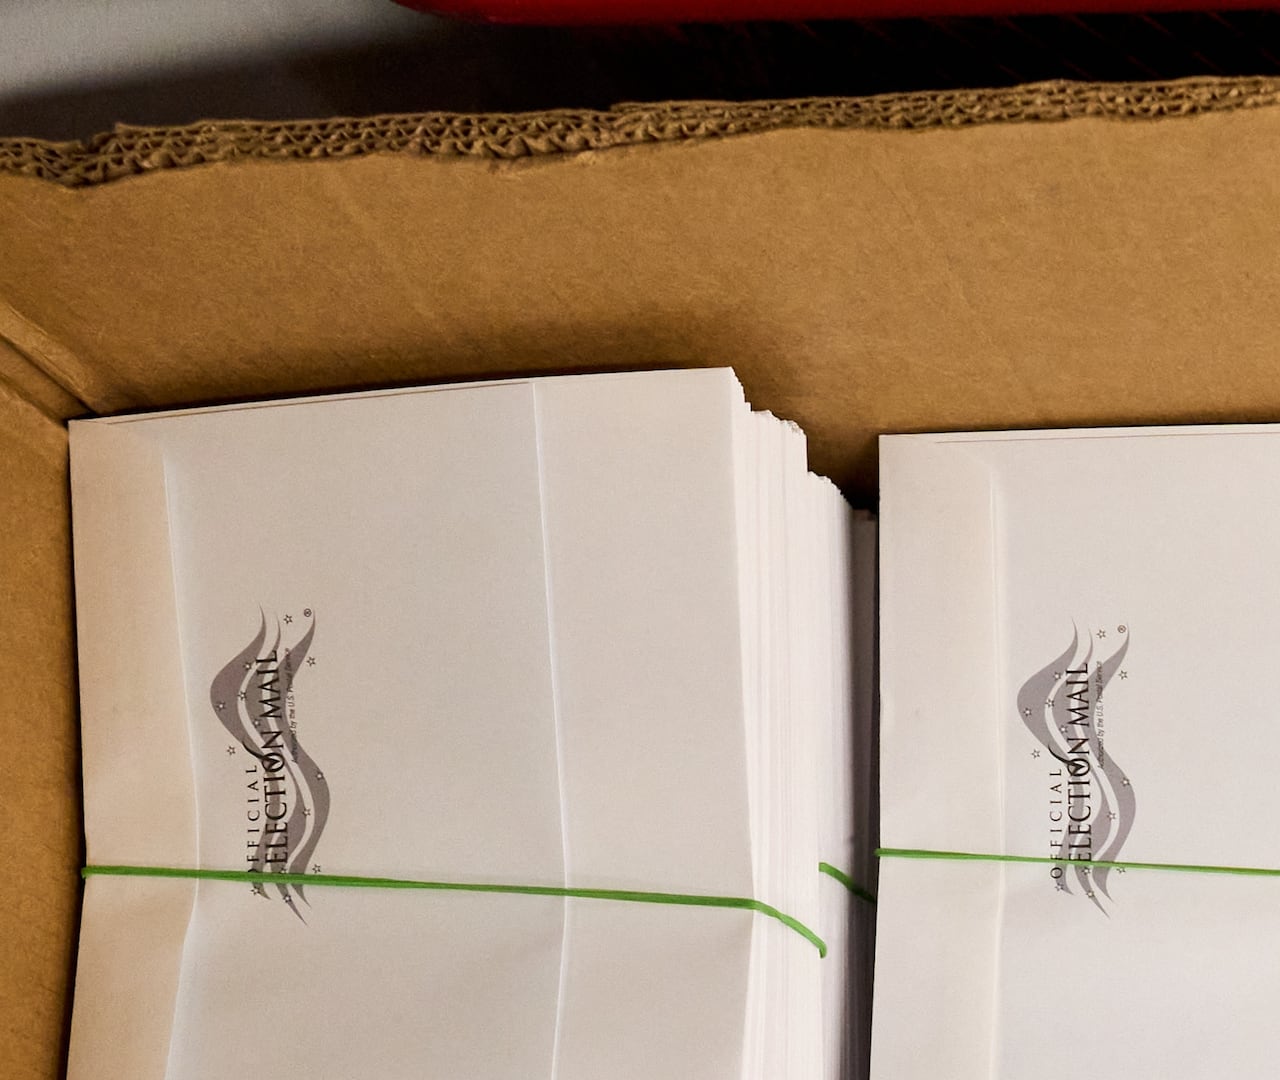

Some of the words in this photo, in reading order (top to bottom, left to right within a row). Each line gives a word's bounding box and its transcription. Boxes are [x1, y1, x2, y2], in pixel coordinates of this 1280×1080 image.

[255, 650, 283, 719] MAIL
[1065, 662, 1090, 727] MAIL
[244, 764, 261, 874] FFICIAL
[260, 729, 288, 864] ELECTION
[1067, 737, 1093, 863] ELECTION
